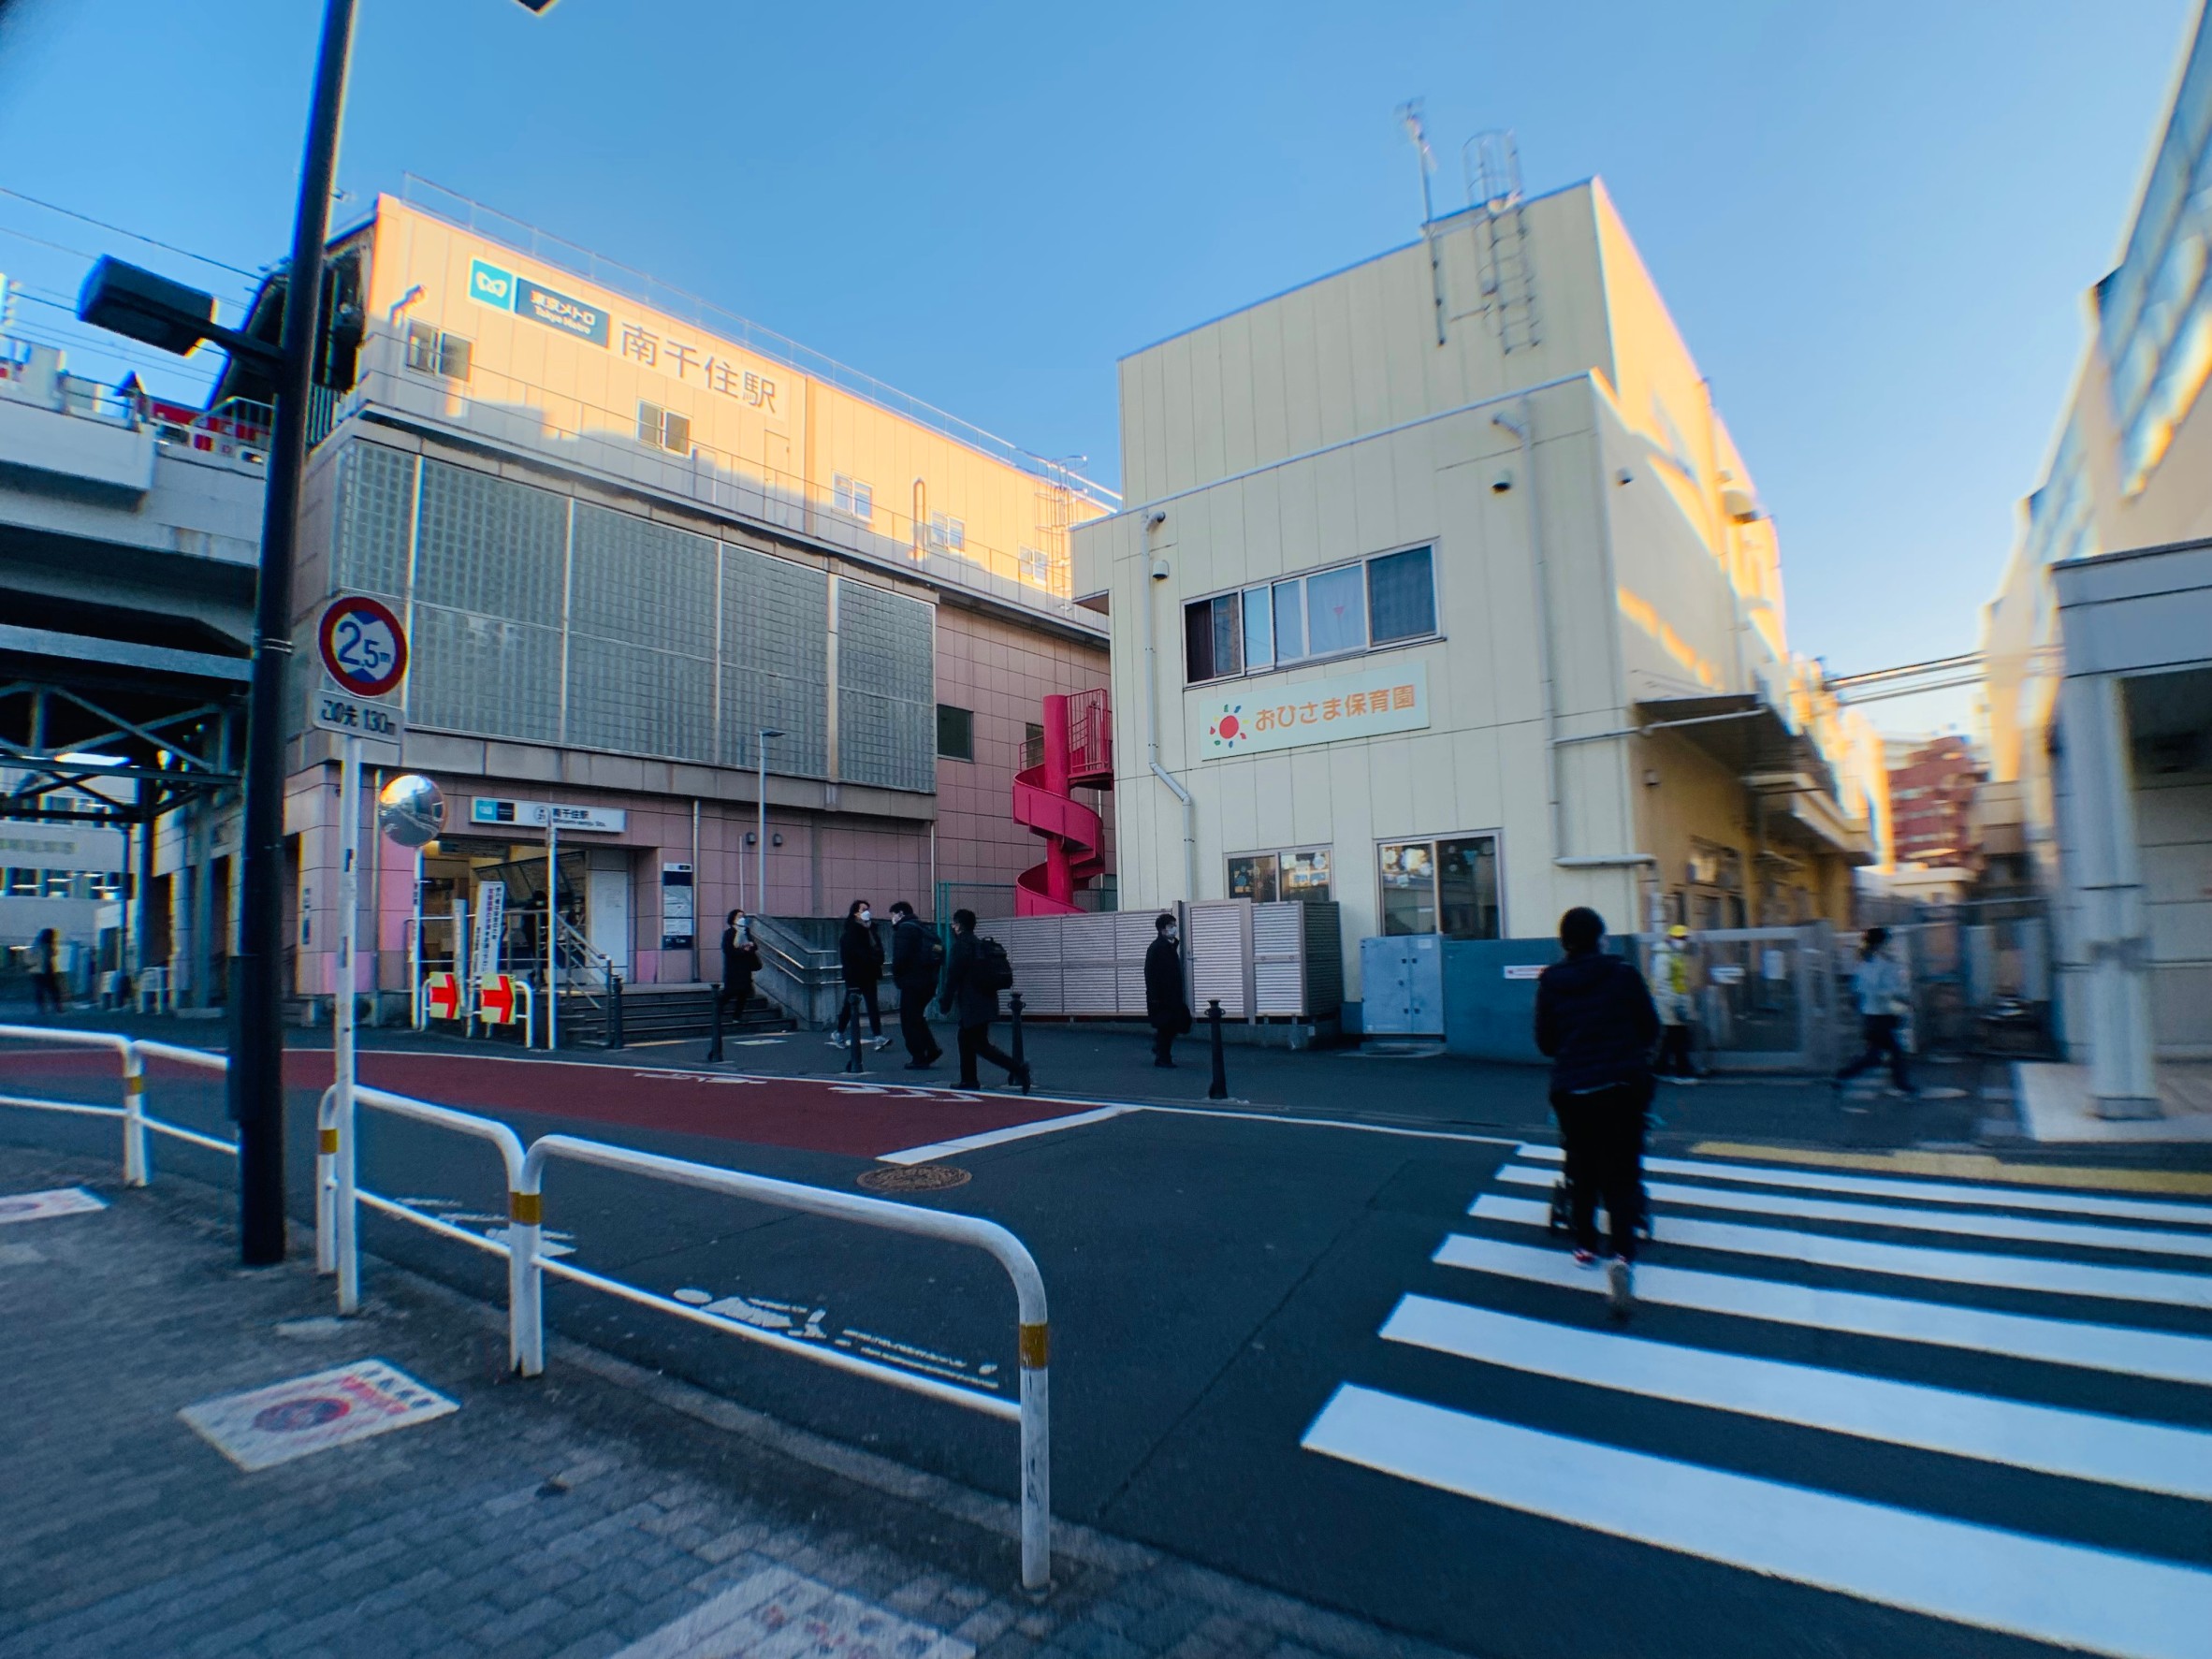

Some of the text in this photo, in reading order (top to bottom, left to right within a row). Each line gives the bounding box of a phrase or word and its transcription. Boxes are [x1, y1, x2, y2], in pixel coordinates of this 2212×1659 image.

[620, 321, 777, 413] 南千住駅
[1255, 684, 1416, 732] おひさま保育園
